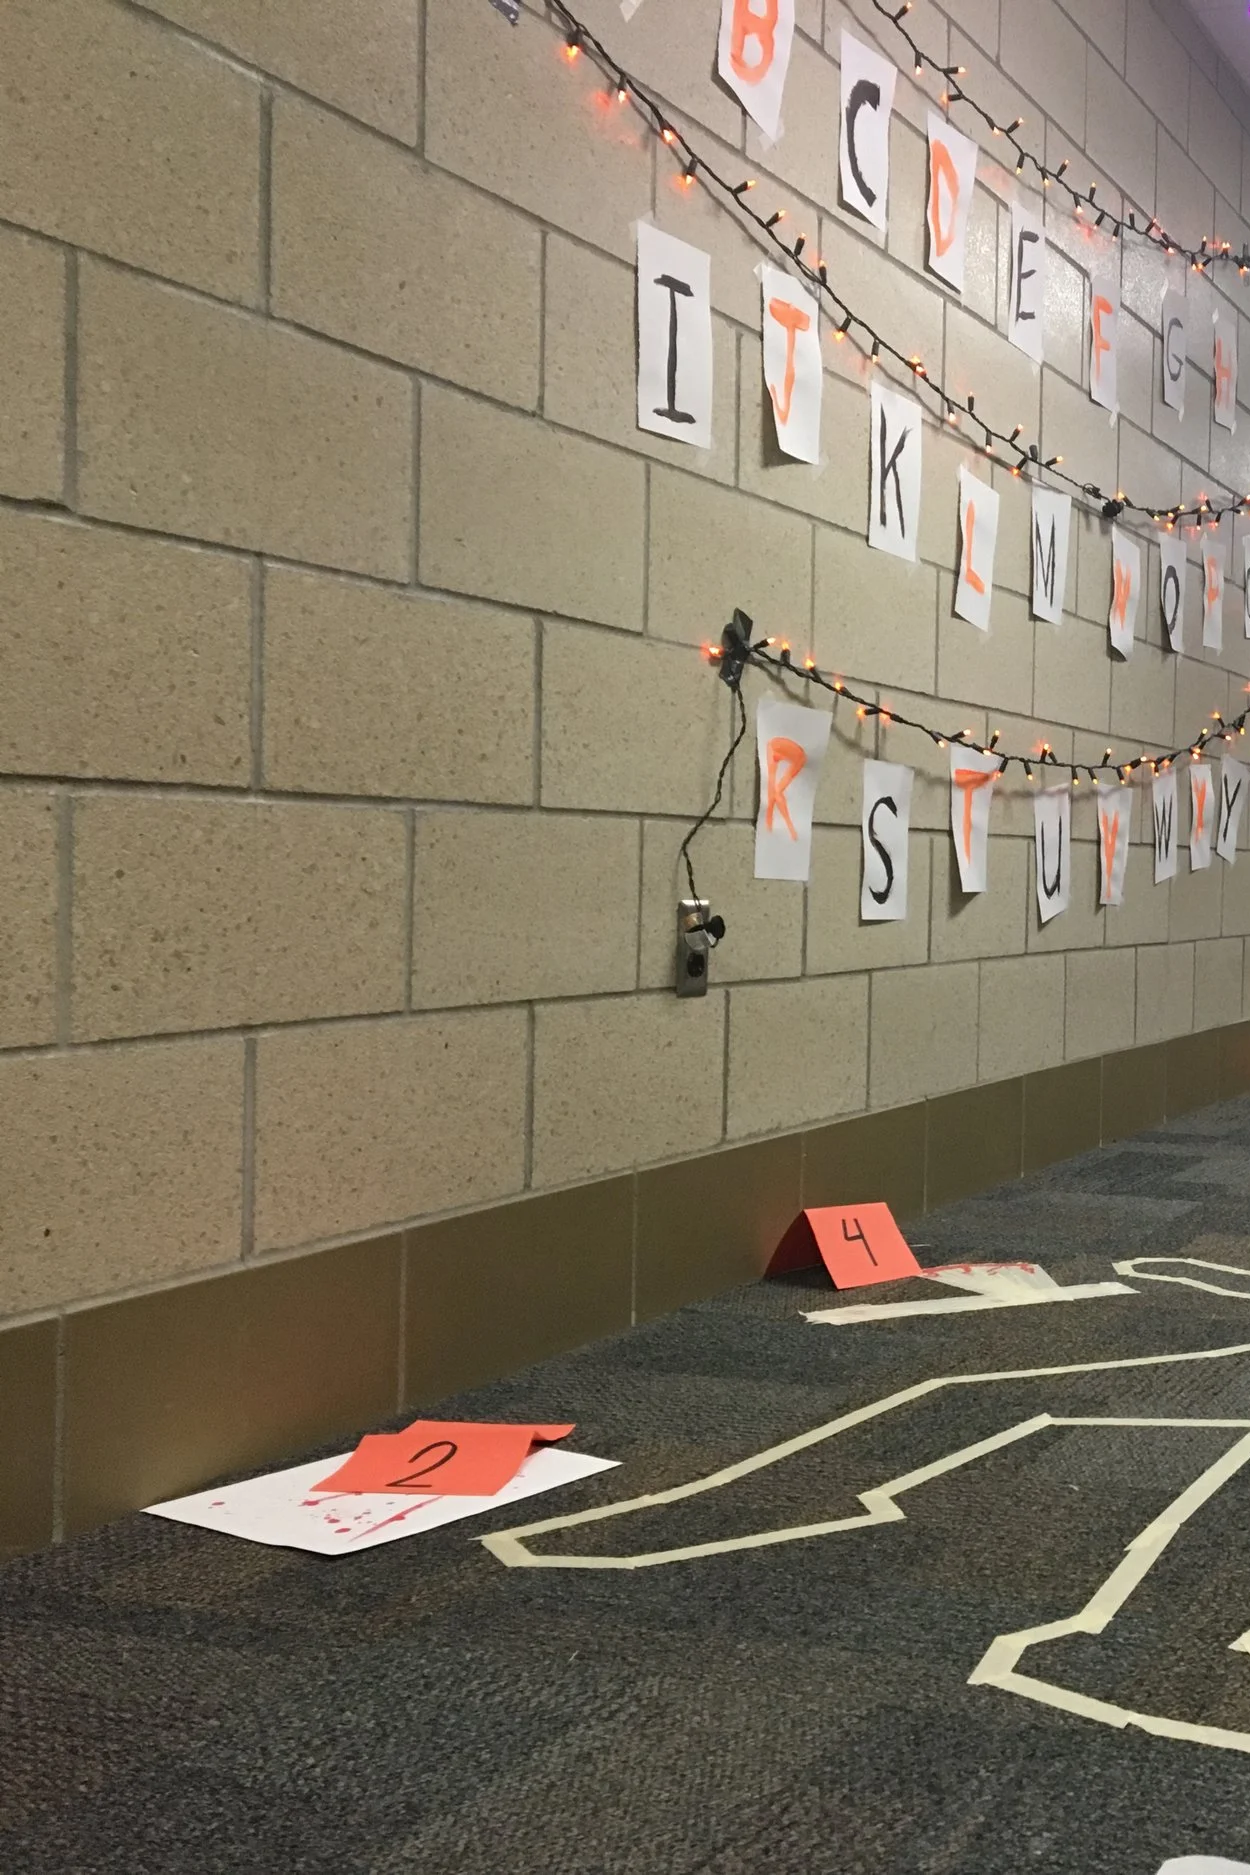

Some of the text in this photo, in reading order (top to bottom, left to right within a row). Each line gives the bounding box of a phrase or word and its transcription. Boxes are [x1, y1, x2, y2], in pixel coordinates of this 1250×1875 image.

[846, 79, 880, 206] C
[931, 140, 959, 257] D
[1016, 226, 1039, 323] E
[653, 274, 696, 424] I
[769, 297, 810, 426] J
[1093, 295, 1113, 382] F
[1166, 317, 1184, 382] G
[1216, 337, 1233, 409] H
[880, 402, 912, 538] K
[964, 500, 985, 595] L
[1035, 513, 1056, 608] M
[1206, 556, 1219, 614] P
[1163, 565, 1180, 633] O
[766, 737, 807, 842] R
[954, 768, 996, 866] T
[1154, 794, 1172, 862] W
[1222, 774, 1241, 843] Y
[868, 796, 898, 904] S
[1041, 814, 1062, 900] U
[841, 1217, 879, 1266] 4
[386, 1440, 458, 1489] 2
